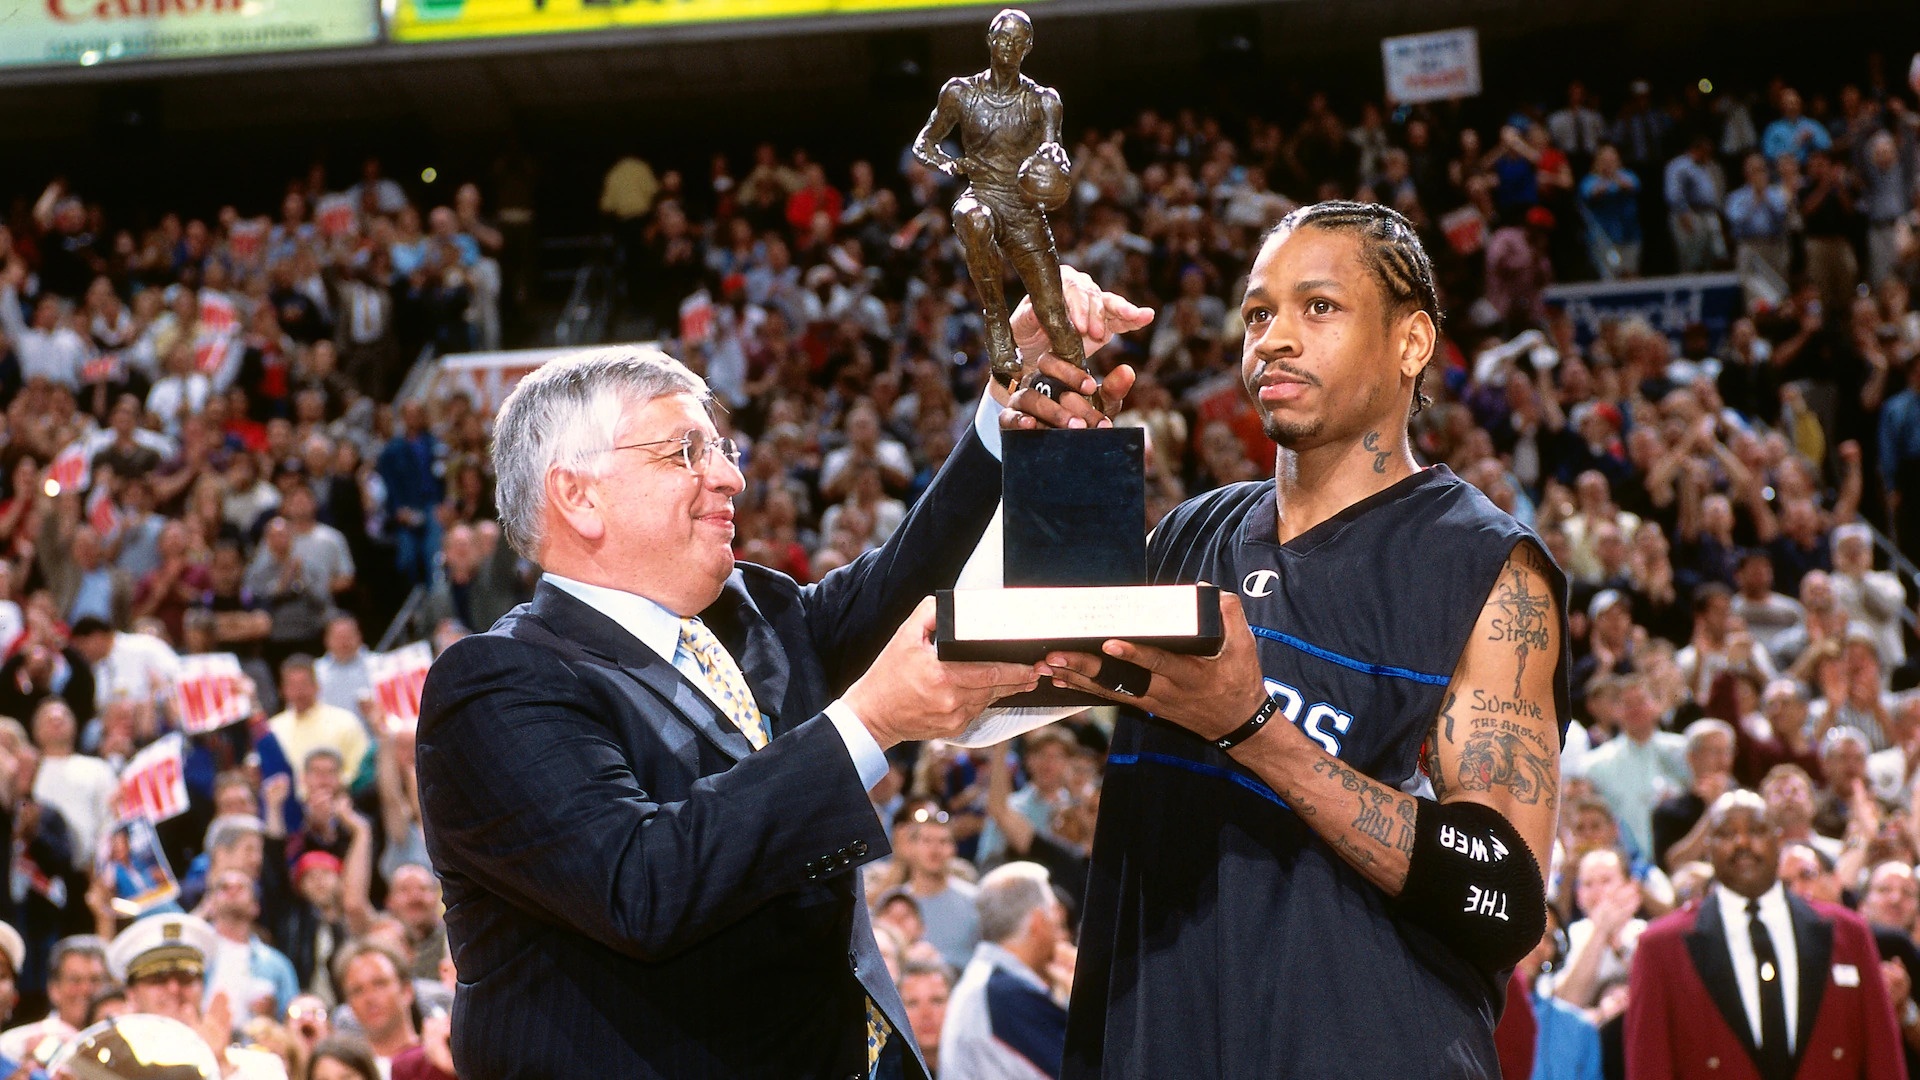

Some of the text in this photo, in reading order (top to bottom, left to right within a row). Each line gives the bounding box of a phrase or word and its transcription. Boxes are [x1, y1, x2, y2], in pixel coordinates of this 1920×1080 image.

[1471, 690, 1544, 721] Survive
[1471, 718, 1498, 729] THE
[1464, 885, 1509, 921] THE
